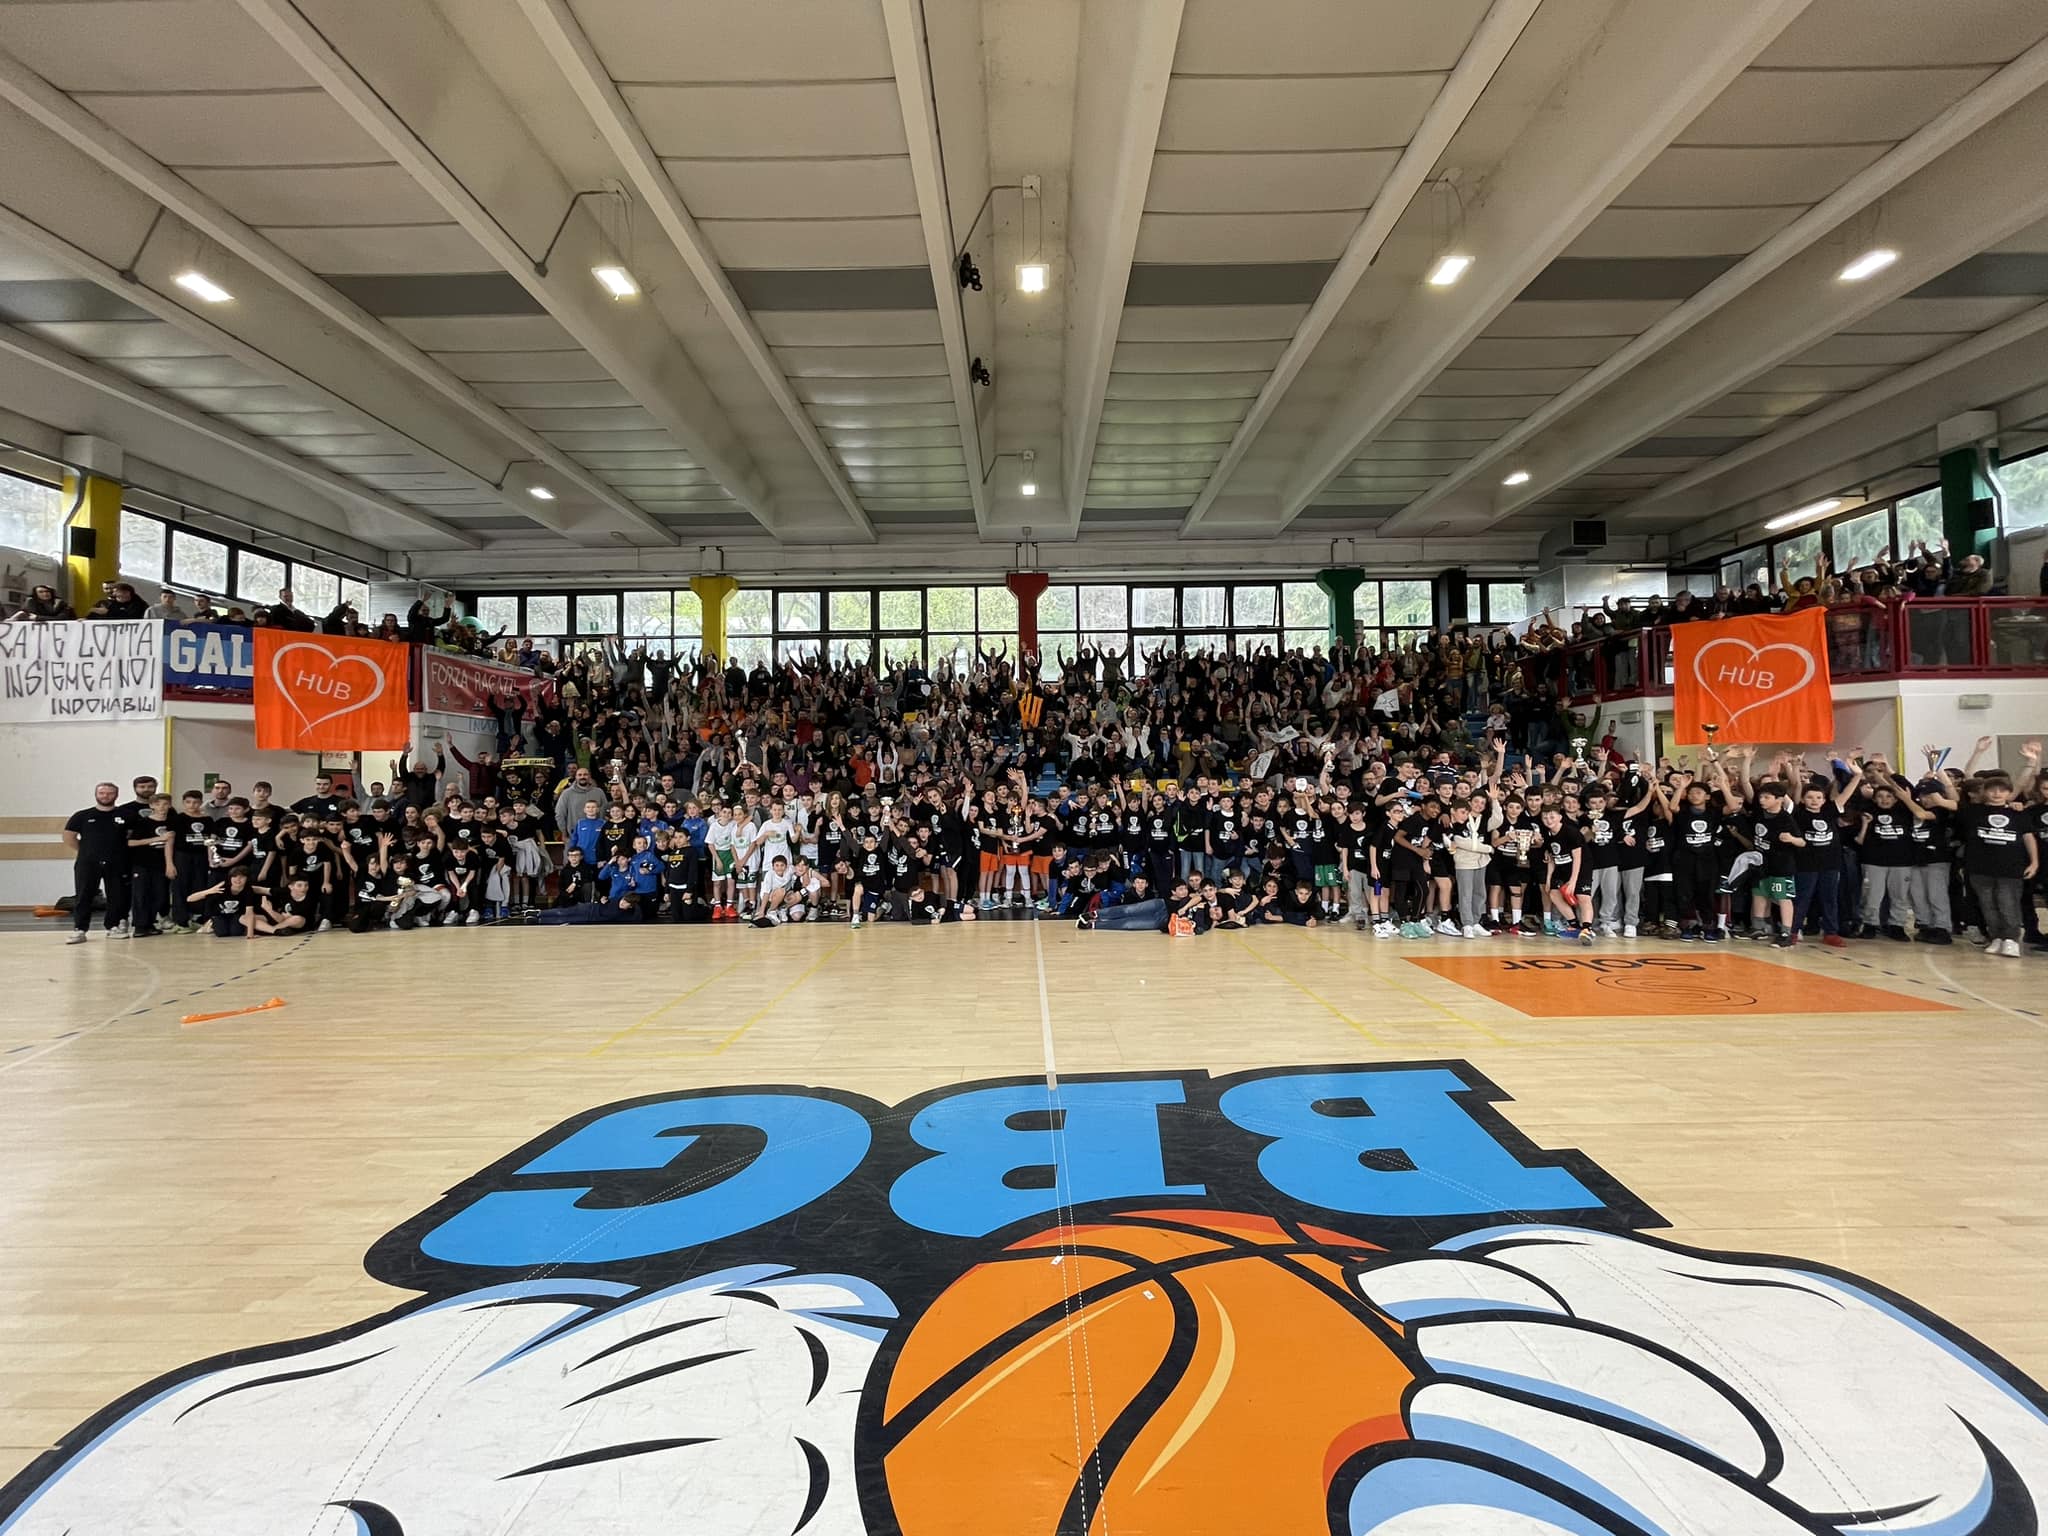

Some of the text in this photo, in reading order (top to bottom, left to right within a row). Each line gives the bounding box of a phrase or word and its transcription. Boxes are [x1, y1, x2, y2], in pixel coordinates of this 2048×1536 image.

[79, 623, 153, 658] LOTTA
[170, 629, 254, 676] GAL
[119, 657, 156, 690] NOI
[296, 670, 352, 700] HUB
[431, 662, 468, 689] FORZA
[1718, 664, 1775, 690] HUB
[52, 696, 156, 715] INDOMABILI
[1501, 958, 1706, 973] Solar
[418, 1070, 1605, 1267] BBG
